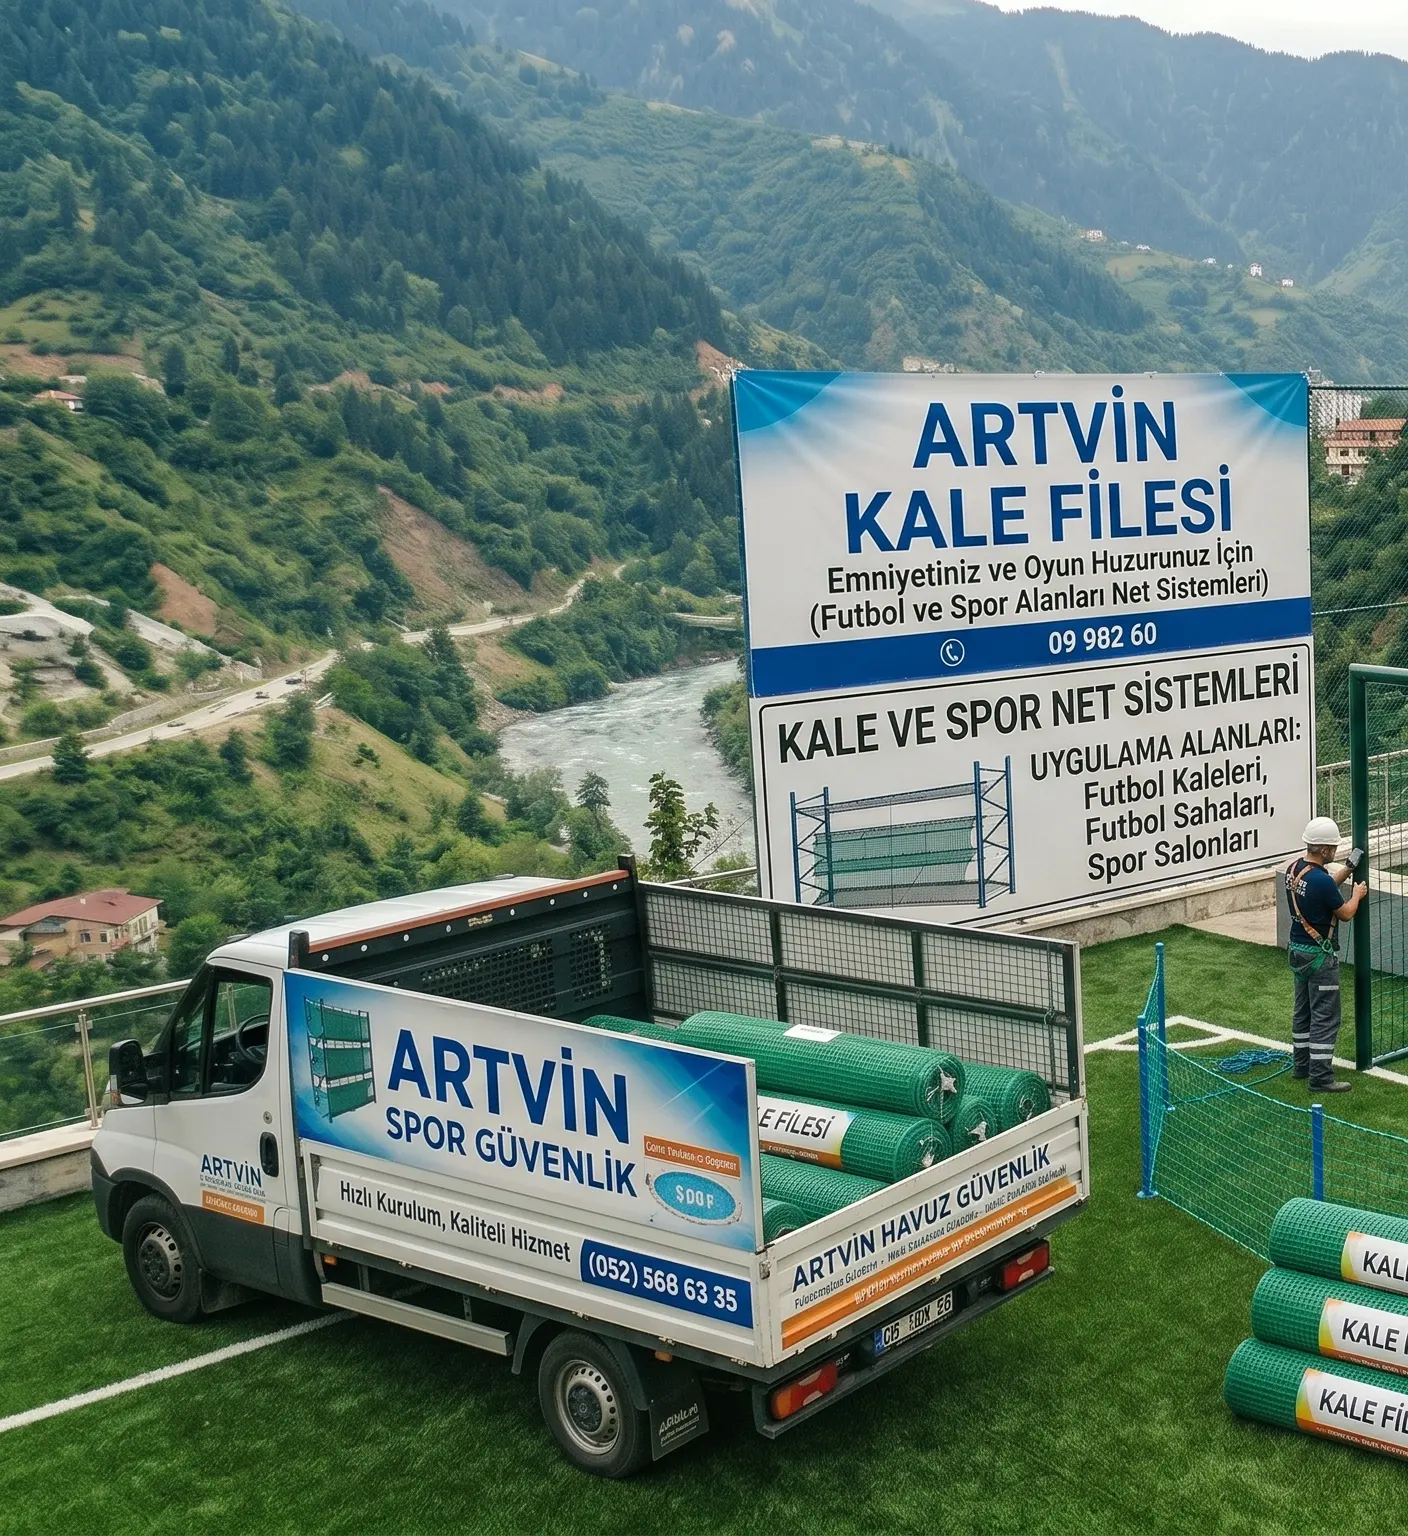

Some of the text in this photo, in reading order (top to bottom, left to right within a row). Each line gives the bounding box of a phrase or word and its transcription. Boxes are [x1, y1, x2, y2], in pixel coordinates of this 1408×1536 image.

[912, 385, 1179, 469] ARTVİN
[845, 464, 1232, 554] KALE FİLESİ
[828, 537, 1253, 602] Emniyetiniz ve Oyun Huzurunuz İçin
[810, 569, 1270, 639] (Futbol ve Spor Alanları Net Sistemleri)
[1049, 622, 1157, 656] 09 982 60
[778, 652, 1300, 763] KALE VE SPOR NET SİSTEMLERİ
[1031, 717, 1301, 781] UYGULAMA ALANLARI:
[1084, 756, 1268, 810] Futbol Kaleleri,
[1086, 792, 1275, 845] Futbol Sahaları,
[1087, 829, 1259, 884] Spor Salonları
[387, 1028, 630, 1144] ARTVİN
[386, 1106, 638, 1198] SPOR GÜVENLİK
[757, 1107, 835, 1139] E FİLESİ
[201, 1154, 261, 1187] ARTVİN
[340, 1181, 571, 1262] Hızlı Kurulum, Kaliteli Hizmet
[792, 1230, 876, 1292] ARTVİN
[882, 1194, 951, 1247] HAVUZ
[956, 1144, 1051, 1208] GÜVENLİK
[588, 1252, 737, 1312] (052) 568 63 35
[1342, 1318, 1400, 1353] KALE
[1319, 1388, 1378, 1425] KALE
